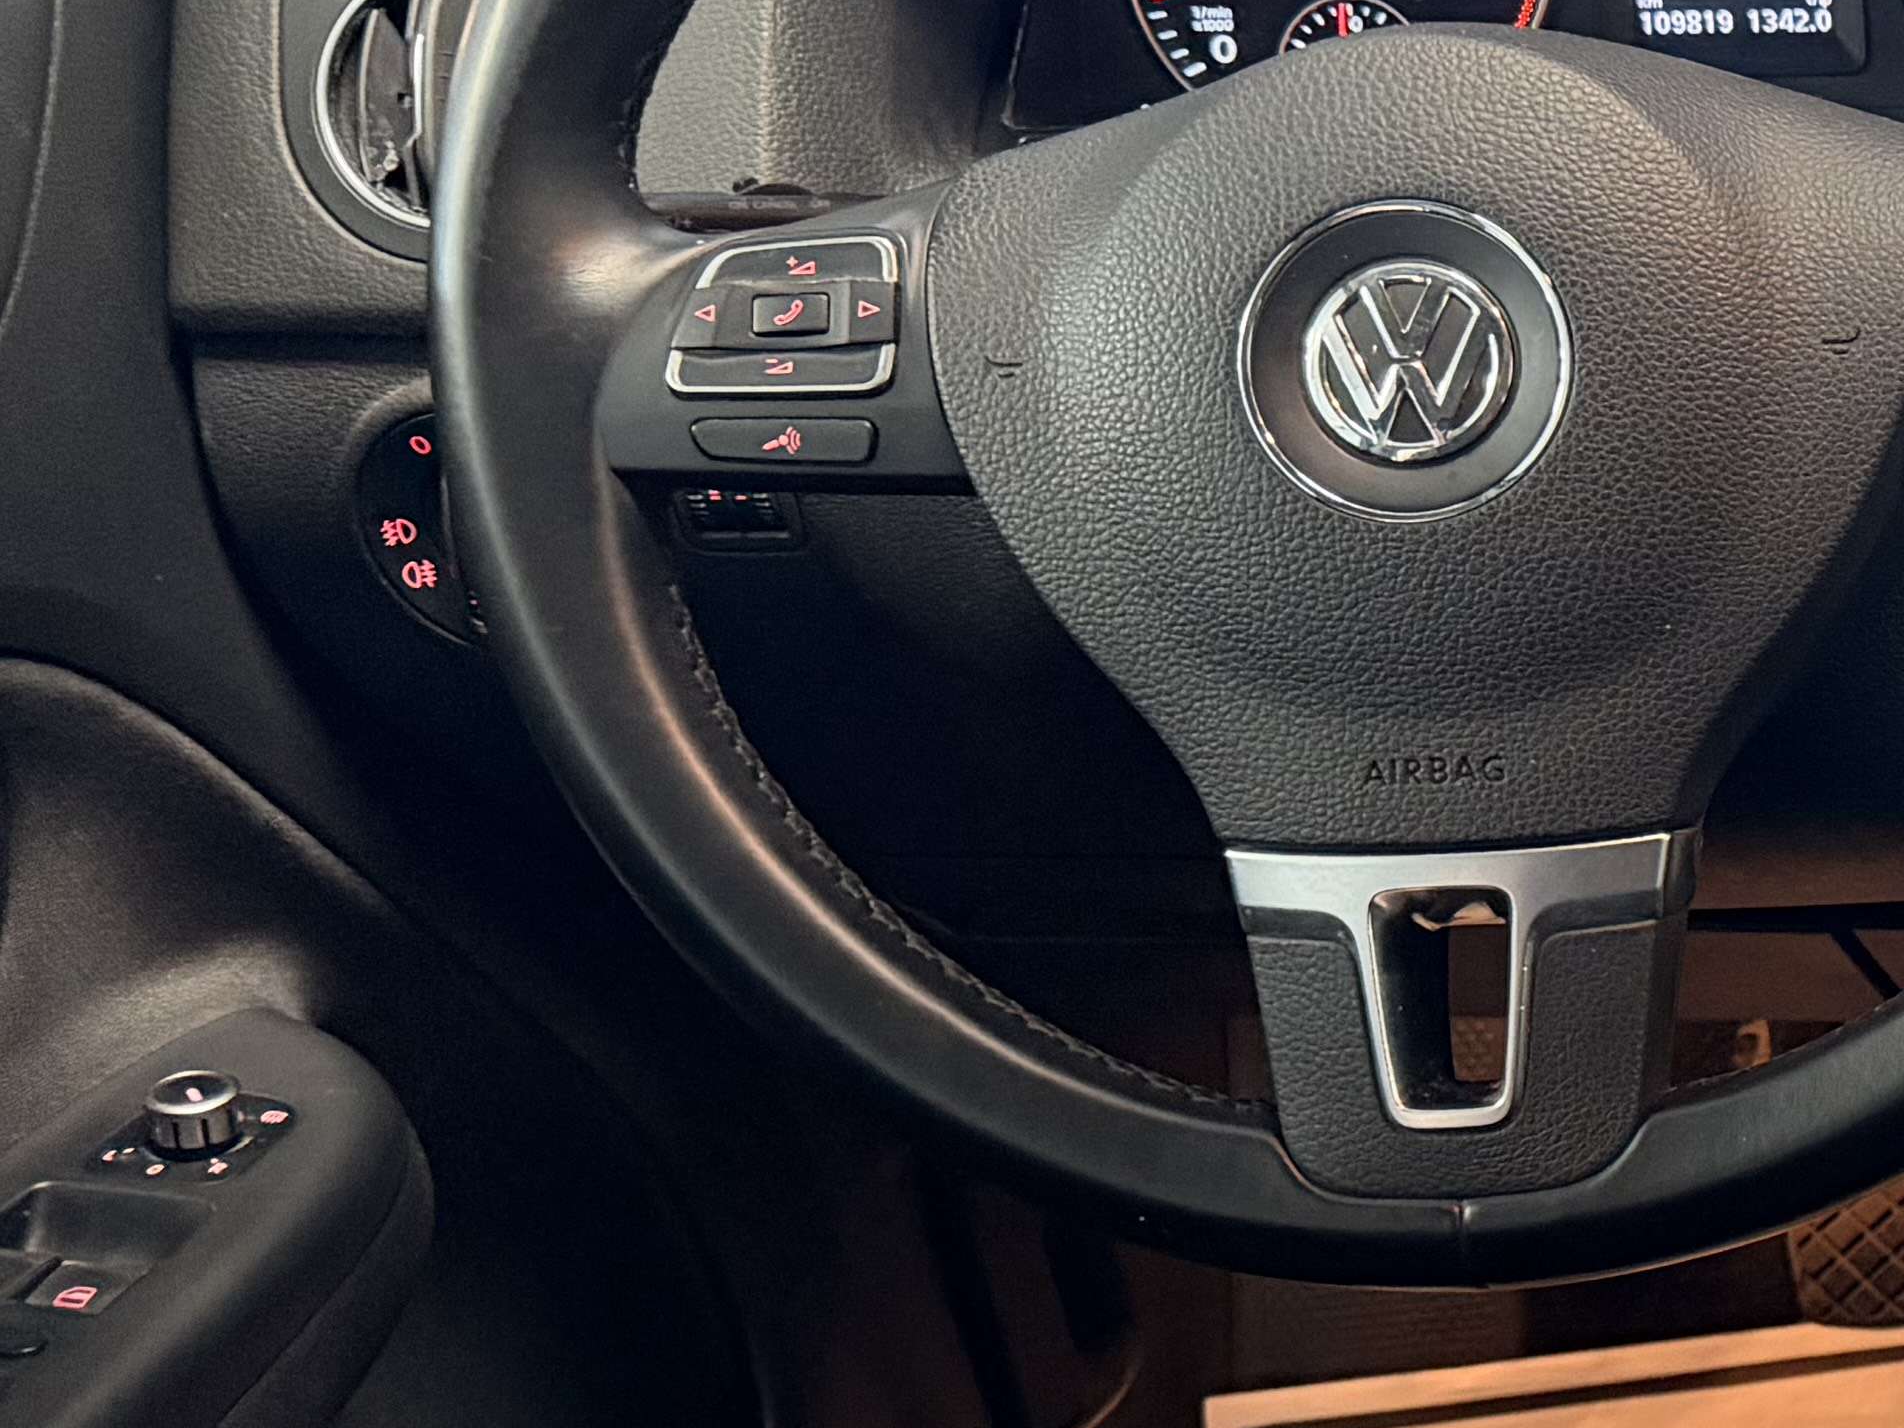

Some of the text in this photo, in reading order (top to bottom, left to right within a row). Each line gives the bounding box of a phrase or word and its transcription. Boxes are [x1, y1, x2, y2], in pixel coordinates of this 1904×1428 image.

[1638, 8, 1833, 36] 109819 1342.0
[1208, 33, 1238, 65] 0
[1363, 753, 1507, 785] AIRBAG
